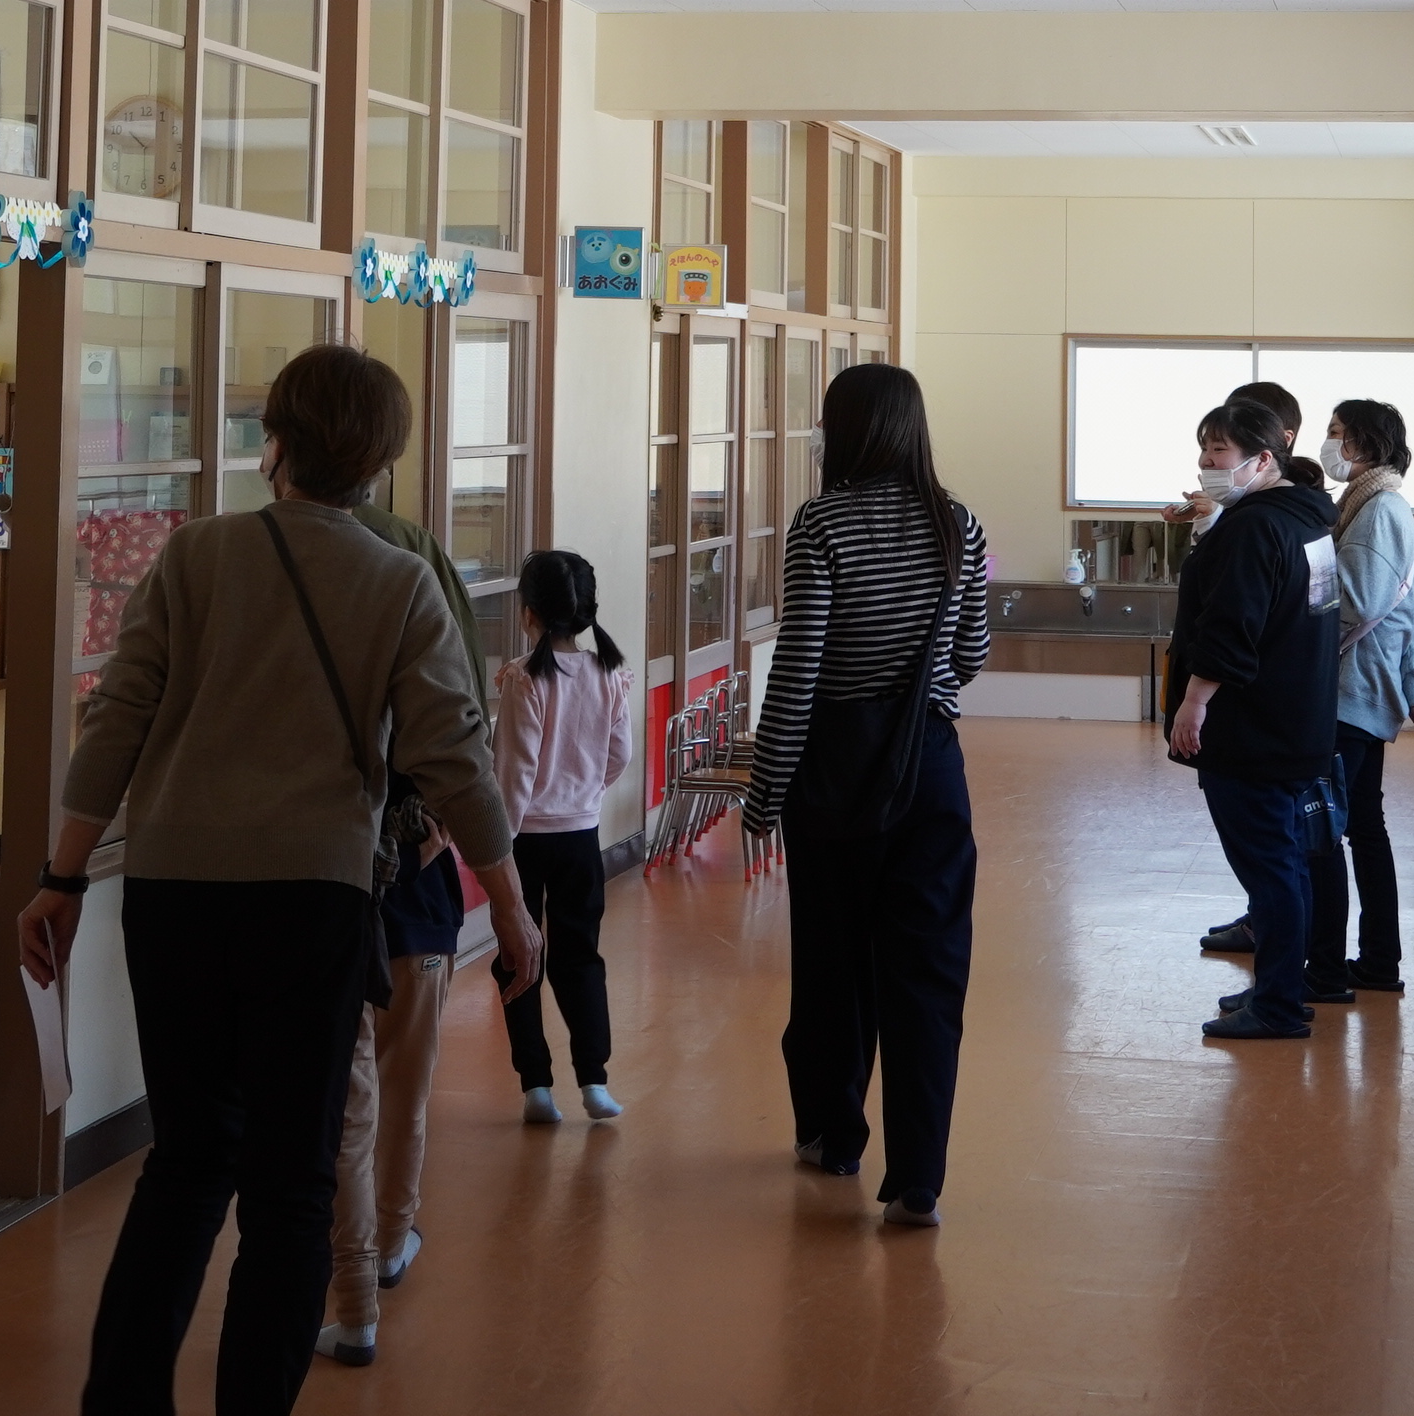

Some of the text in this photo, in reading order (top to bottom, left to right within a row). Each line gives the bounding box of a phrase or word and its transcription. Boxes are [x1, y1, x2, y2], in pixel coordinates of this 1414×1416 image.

[140, 107, 152, 116] 12
[160, 111, 165, 122] 1
[124, 112, 133, 122] 11
[111, 125, 122, 135] 10
[172, 126, 178, 135] 2
[107, 144, 113, 153] 9
[112, 162, 118, 171] 8
[170, 162, 177, 172] 4
[124, 175, 130, 185] 7
[140, 178, 147, 190] 6
[158, 175, 165, 184] 5
[669, 253, 719, 268] えほんのへや
[578, 274, 638, 292] あおぐみ
